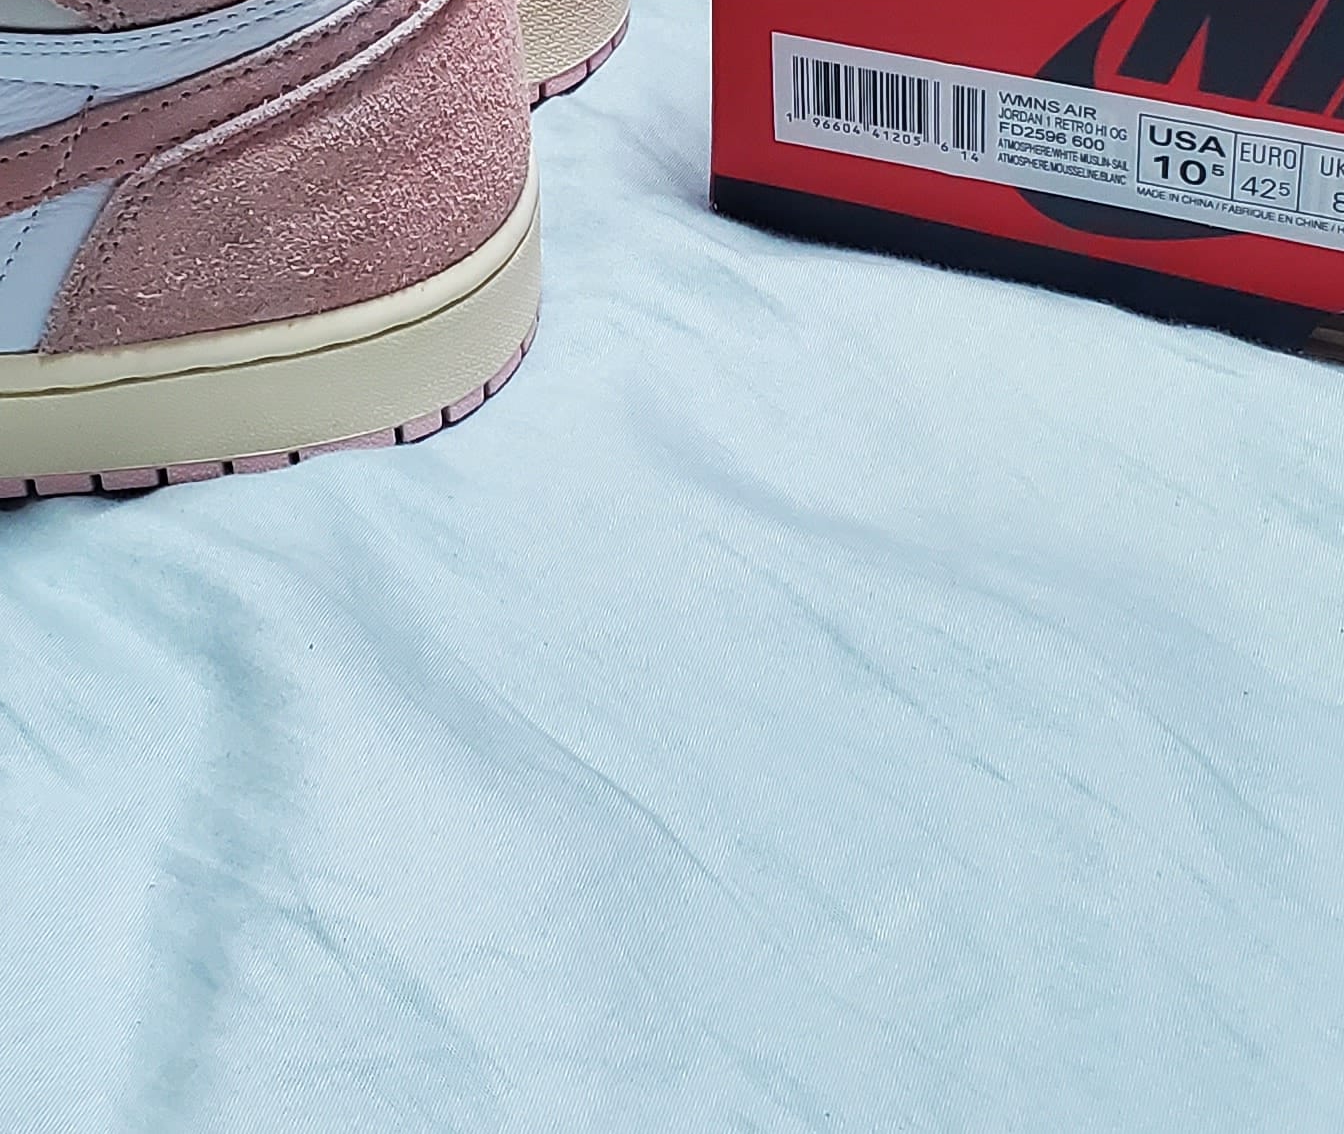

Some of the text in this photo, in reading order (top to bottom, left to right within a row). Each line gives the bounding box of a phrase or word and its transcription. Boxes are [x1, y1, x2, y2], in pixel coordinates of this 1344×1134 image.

[998, 91, 1097, 121] WMNS AIR
[812, 117, 862, 136] 96604
[872, 129, 922, 147] 41205
[998, 106, 1128, 141] JORDAN 1 RETRO HI OG
[999, 121, 1105, 152] FD2596 600
[1148, 124, 1226, 158] USA
[1239, 141, 1298, 170] EURO
[1136, 186, 1167, 201] MADE
[1169, 193, 1180, 203] IN
[1181, 194, 1215, 210] CHINA
[1221, 202, 1277, 222] FABRIQUE
[1278, 213, 1293, 225] EN
[1295, 215, 1329, 232] CHINE
